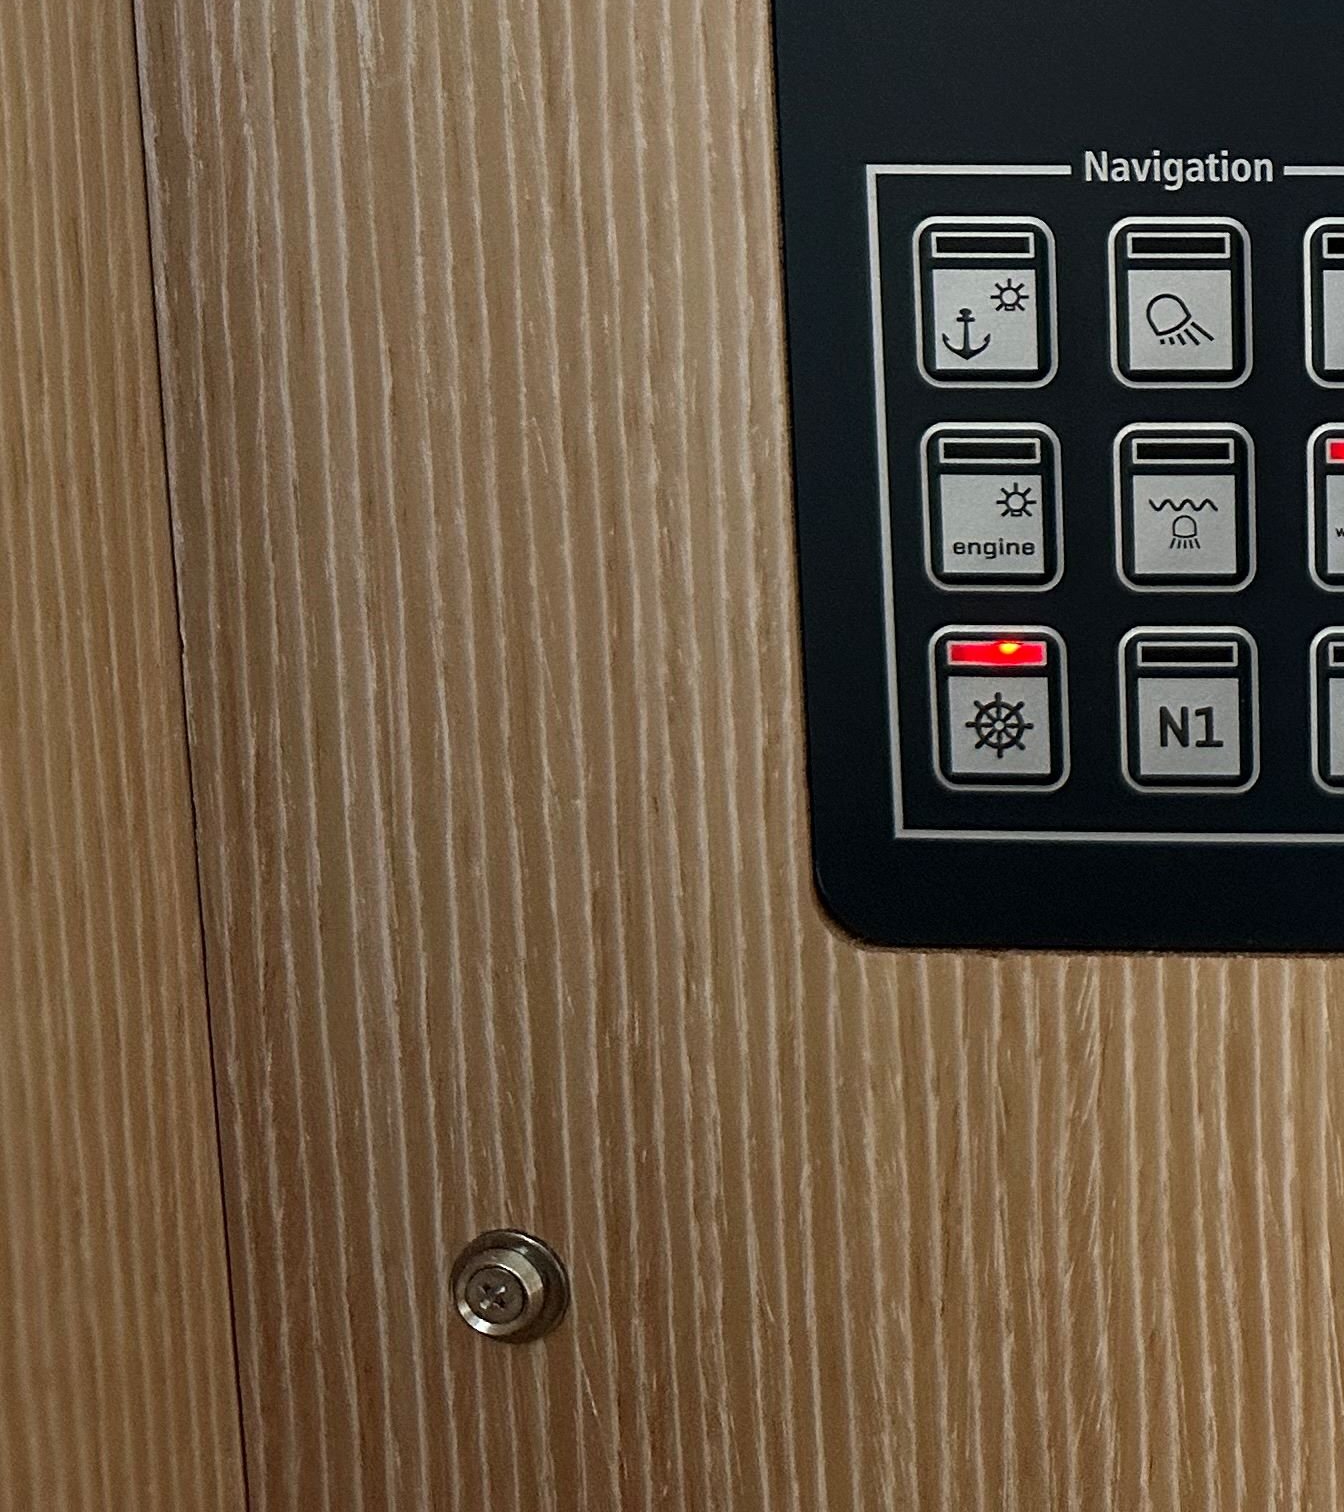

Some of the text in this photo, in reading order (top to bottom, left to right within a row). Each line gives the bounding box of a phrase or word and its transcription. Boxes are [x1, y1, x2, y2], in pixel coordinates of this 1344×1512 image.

[1083, 150, 1275, 190] Navigation
[952, 536, 1036, 560] engine
[1158, 706, 1224, 748] N1
